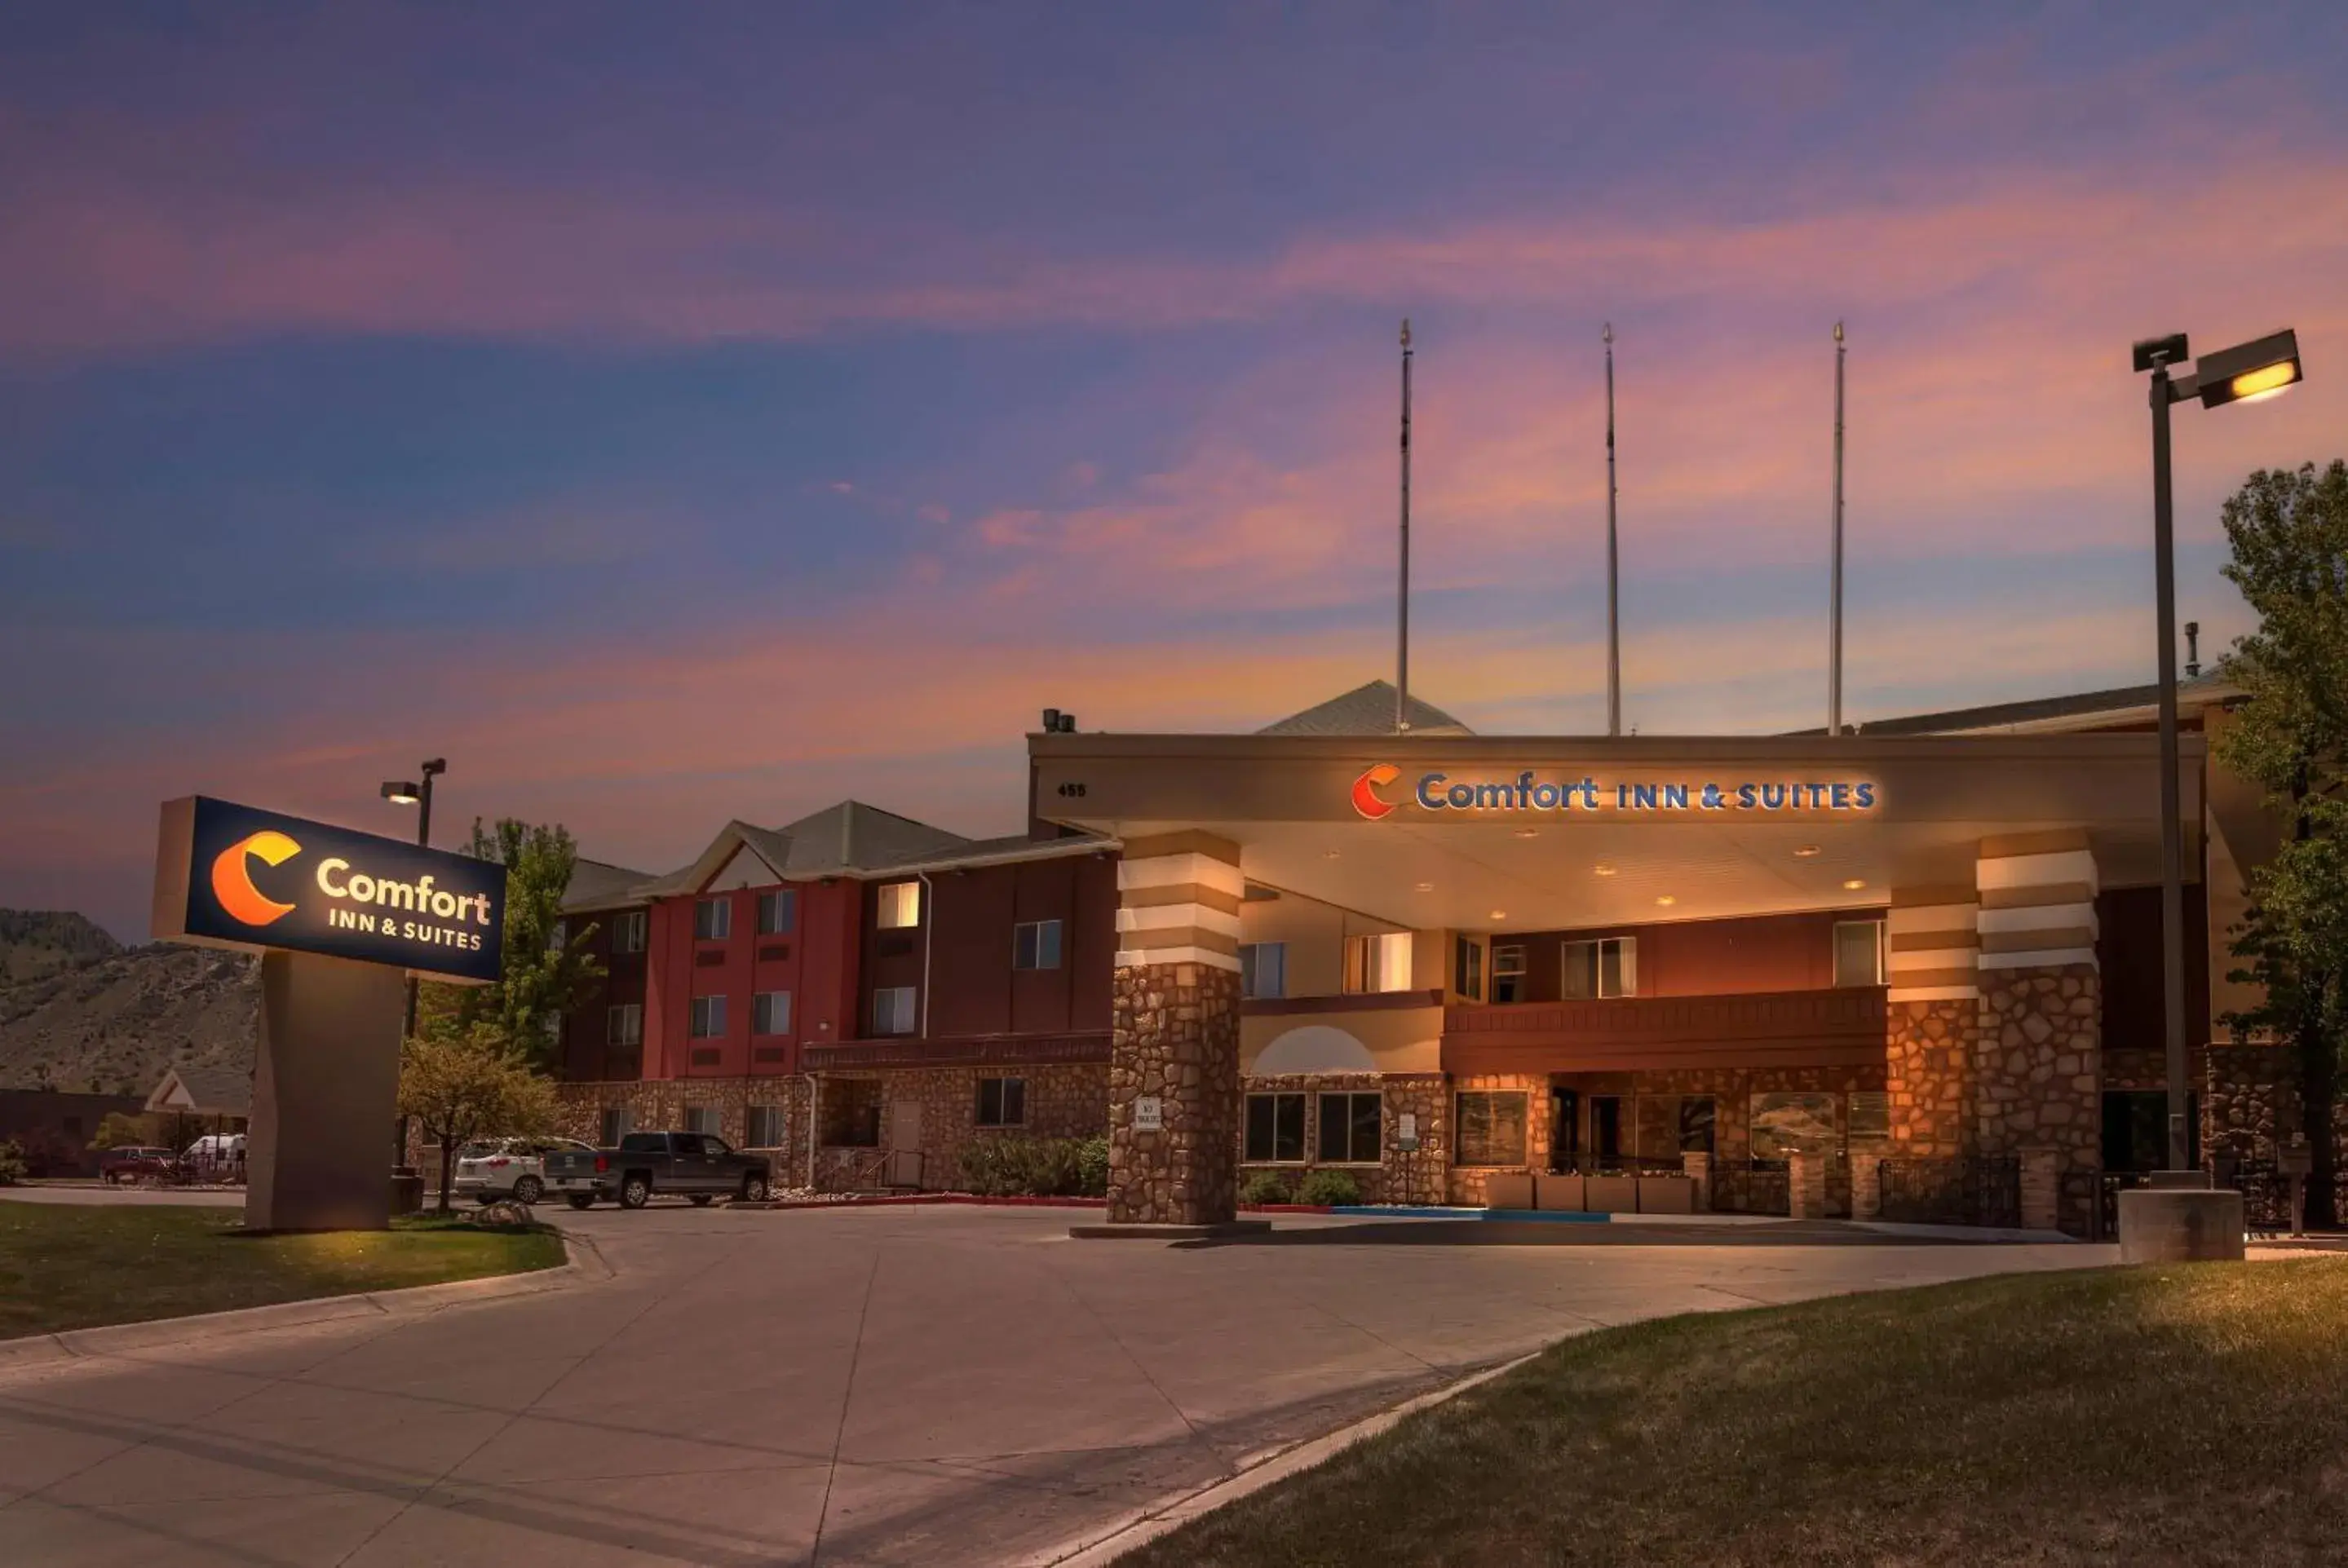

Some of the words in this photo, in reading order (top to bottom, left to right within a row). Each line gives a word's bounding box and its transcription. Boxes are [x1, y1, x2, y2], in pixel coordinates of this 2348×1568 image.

[1417, 771, 1598, 810] Comfort
[1617, 783, 1688, 809] INN
[1701, 783, 1726, 810] &
[1736, 783, 1875, 810] SUITES
[317, 858, 491, 925] Comfort
[329, 908, 375, 933] INN
[381, 918, 397, 936] &
[404, 922, 481, 951] SUITES
